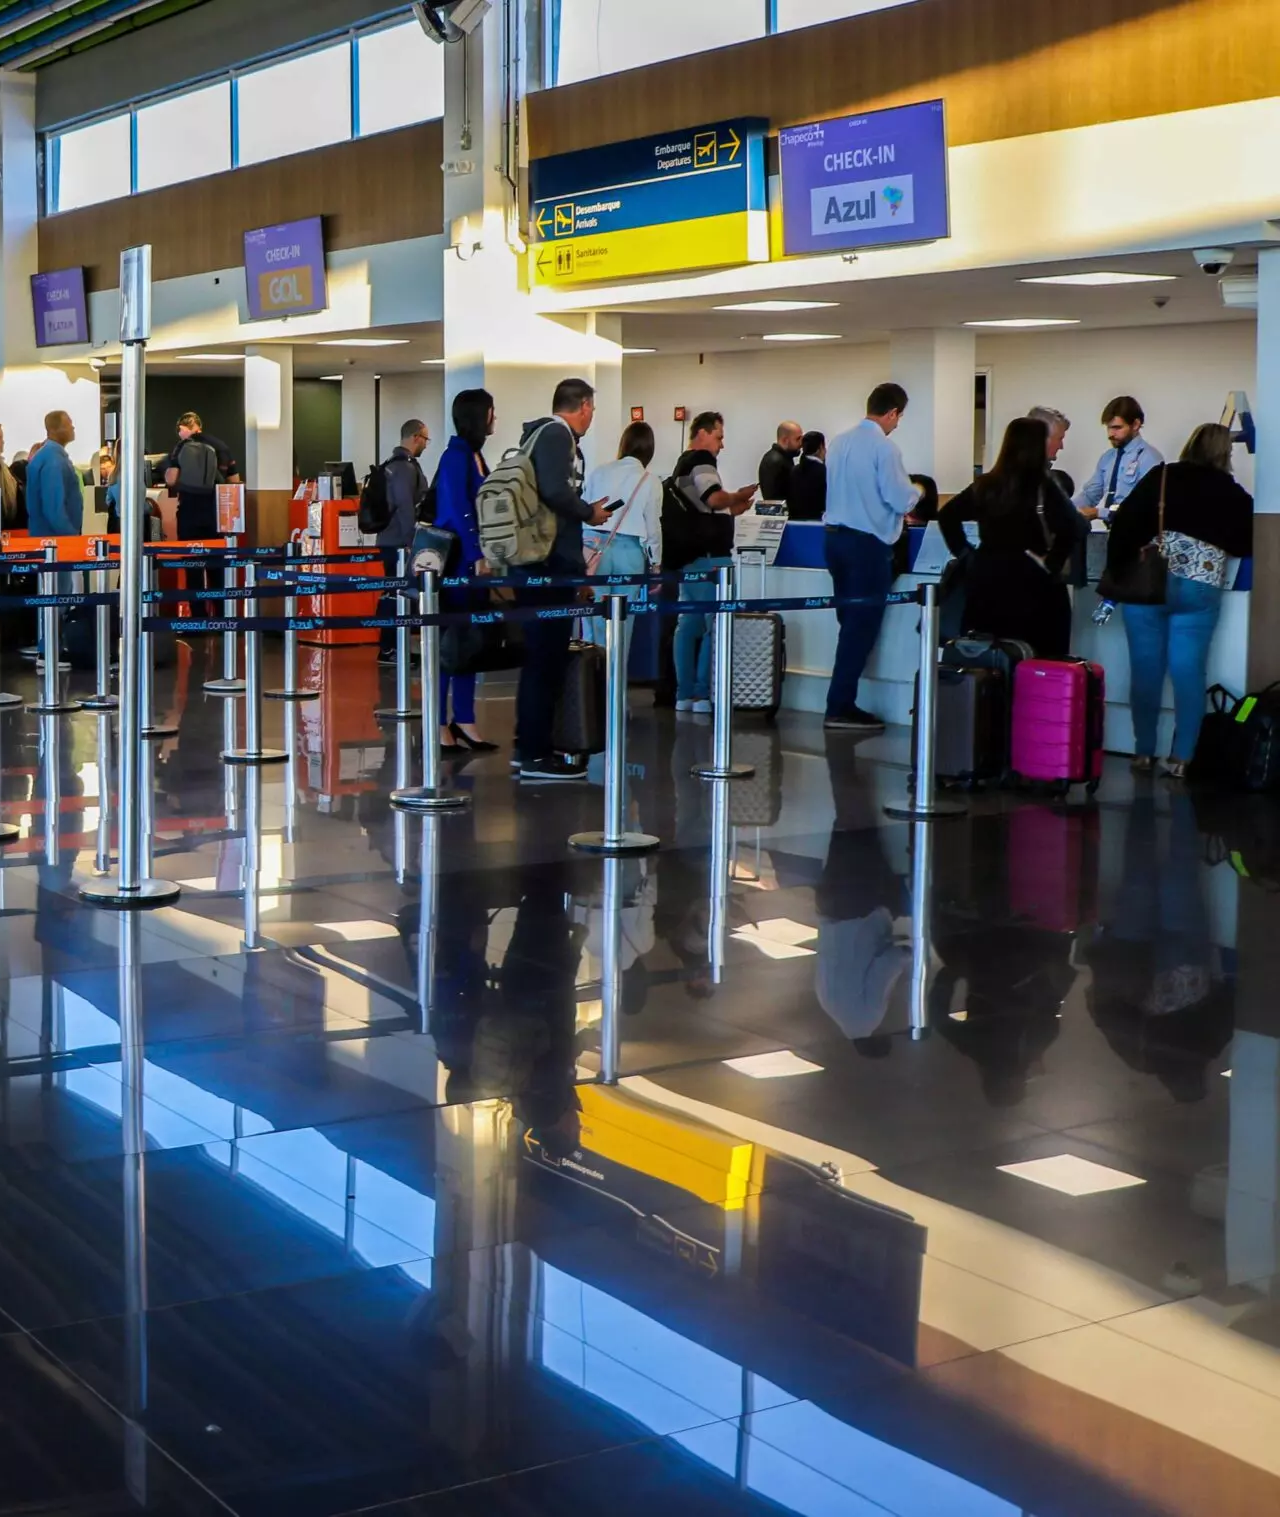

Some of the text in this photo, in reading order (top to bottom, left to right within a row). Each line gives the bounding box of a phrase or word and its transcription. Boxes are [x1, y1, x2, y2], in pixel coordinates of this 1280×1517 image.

[655, 140, 691, 156] Embarque
[657, 156, 692, 170] Departures
[823, 144, 895, 172] CHECK-IN
[576, 200, 621, 215] Desembarque
[824, 190, 876, 225] Azul
[576, 217, 598, 229] Arrivals
[266, 244, 300, 263] CHECK-IN
[576, 246, 608, 258] Sanitários
[270, 274, 303, 304] GOL
[12, 564, 30, 573] Azul
[73, 562, 119, 570] voeazul.com.br
[443, 577, 460, 585] Azul
[527, 577, 543, 585] Azul
[607, 576, 623, 584] Azul
[684, 573, 700, 581] Azul
[296, 586, 317, 594] Azul
[356, 580, 409, 590] voeazul.com.br
[196, 589, 253, 598] voeazul.com.br
[25, 595, 86, 605] voeazul.com.br
[629, 602, 647, 612] Azul
[719, 602, 737, 610] Azul
[536, 607, 595, 618] voeazul.com.br
[360, 618, 423, 627] voeazul.com.br
[471, 612, 494, 624] Azul
[170, 619, 238, 630] voeazul.com.br
[288, 619, 313, 630] Azul
